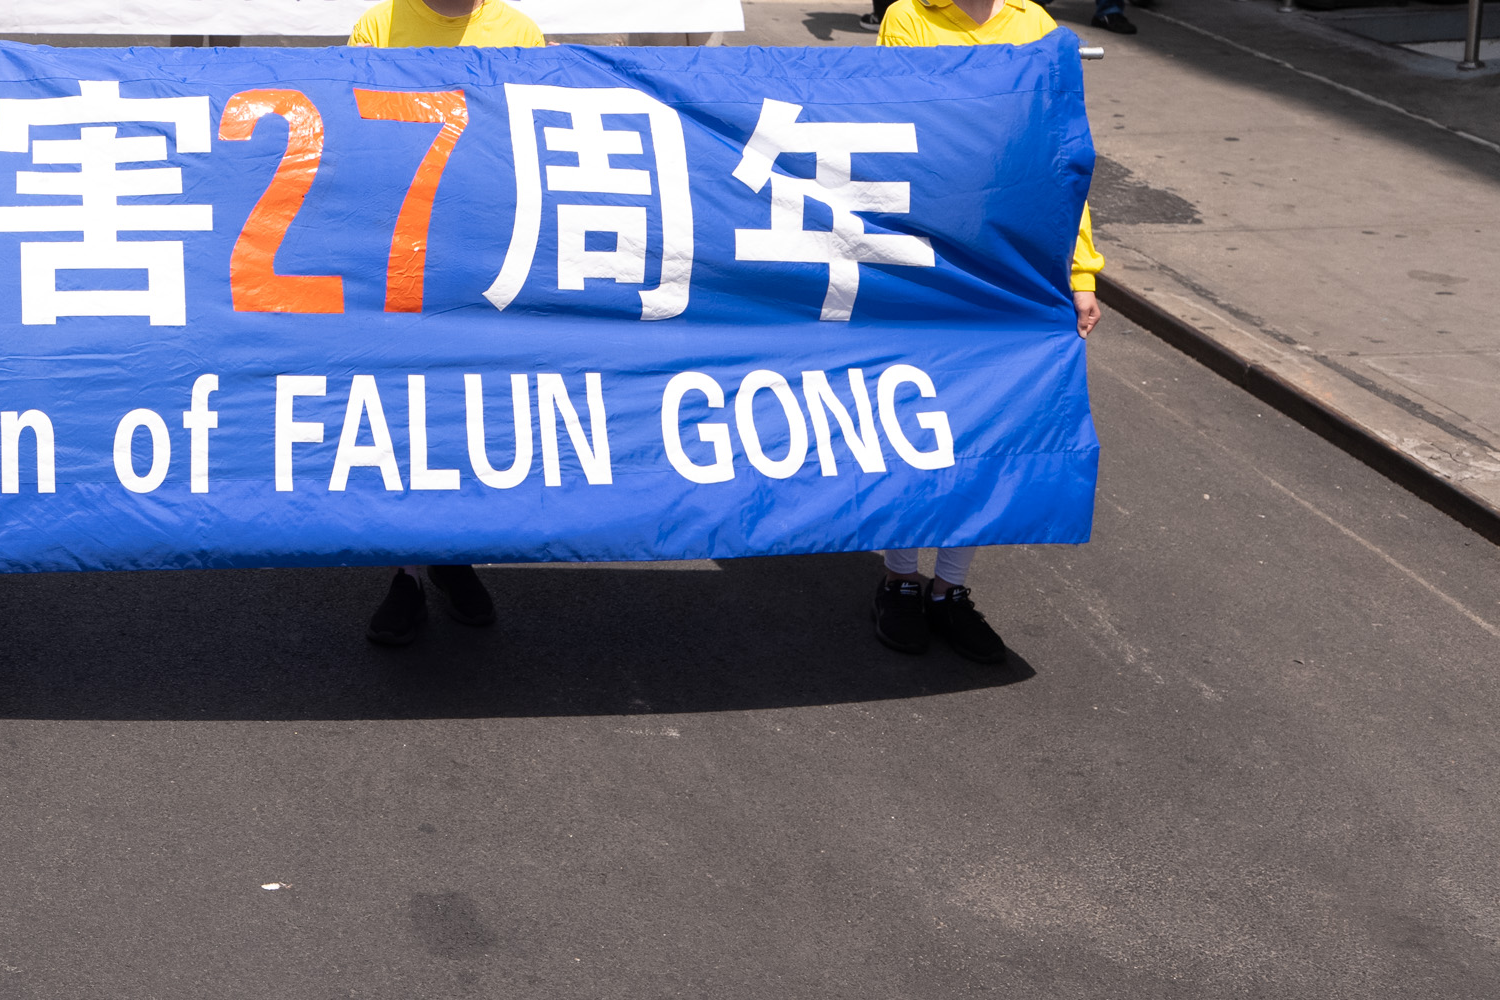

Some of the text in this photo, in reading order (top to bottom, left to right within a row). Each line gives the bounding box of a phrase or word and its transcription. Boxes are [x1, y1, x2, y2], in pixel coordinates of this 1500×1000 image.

[112, 373, 219, 494] of
[274, 372, 614, 492] FALUN
[660, 363, 956, 485] GONG
